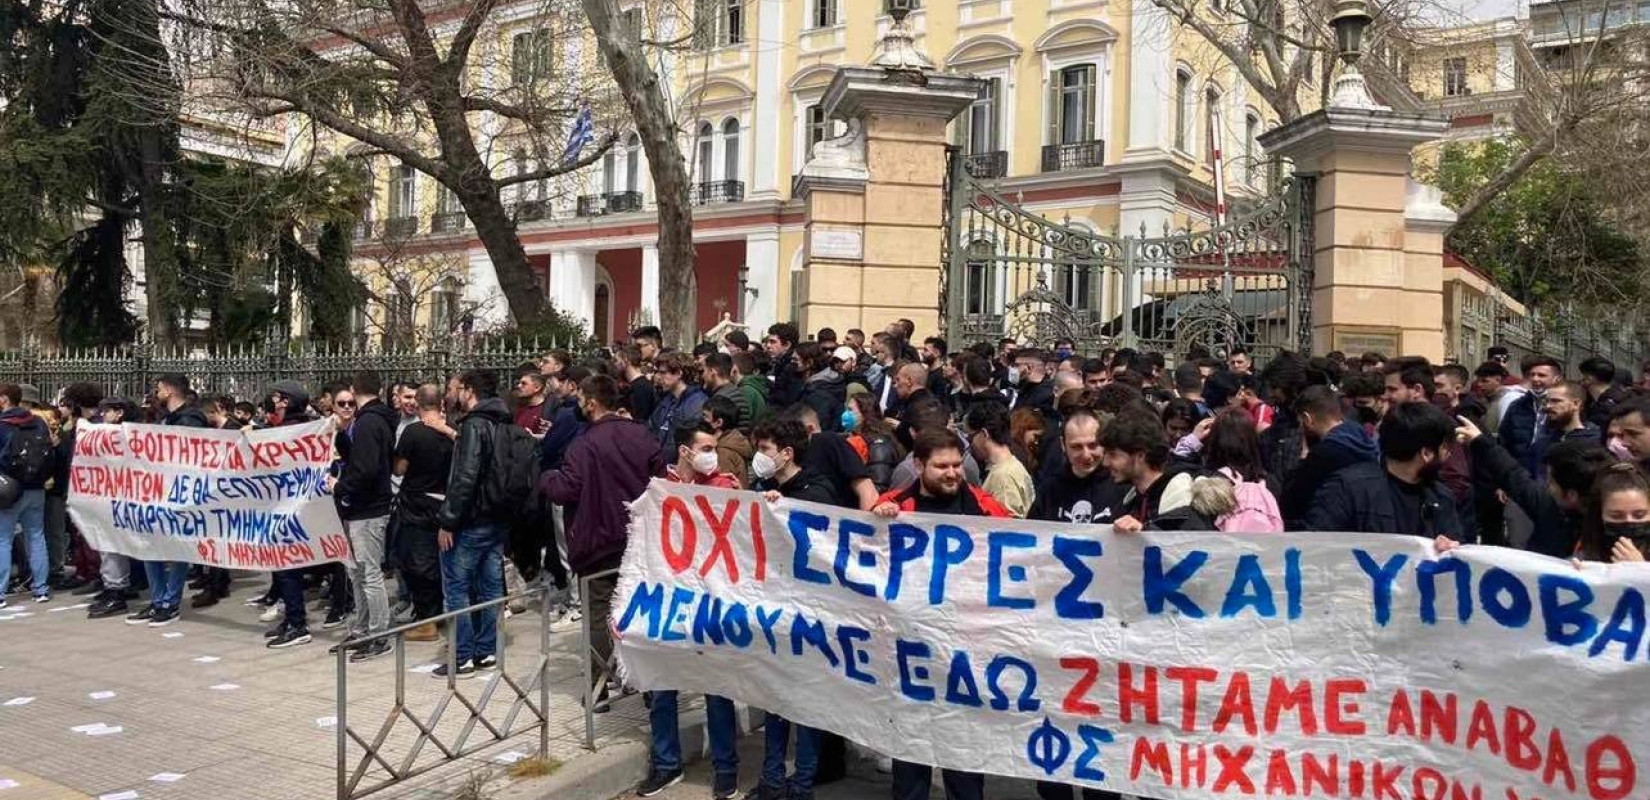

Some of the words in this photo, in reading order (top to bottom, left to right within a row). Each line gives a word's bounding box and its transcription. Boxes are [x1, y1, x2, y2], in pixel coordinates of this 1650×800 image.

[129, 429, 220, 469] ΦΟΙΤΗΤΕΣ
[248, 432, 334, 468] ΧΡΗΣΗ
[167, 474, 190, 505] ΔΕ
[193, 473, 219, 505] ΘΑ
[112, 500, 207, 537] ΚΑΤΑΡΓΗΣΗ
[210, 508, 310, 544] ΤΜΗΜΑΤΩΝ
[660, 494, 767, 583] ΟΧΙ
[787, 509, 1103, 620] ΣΕΡΡΕΣ
[1143, 546, 1304, 621] ΚΑΙ
[1353, 548, 1650, 662] ΥΠΟΒΑ
[618, 581, 877, 684] ΜΕΝΟΥΜΕ
[898, 640, 1041, 712] ΕΔΩ
[1060, 657, 1367, 737] ΖΗΤΑΜΕ
[1386, 689, 1636, 800] ΑΝΑΒΑΘ
[1026, 717, 1116, 783] ΦΣ
